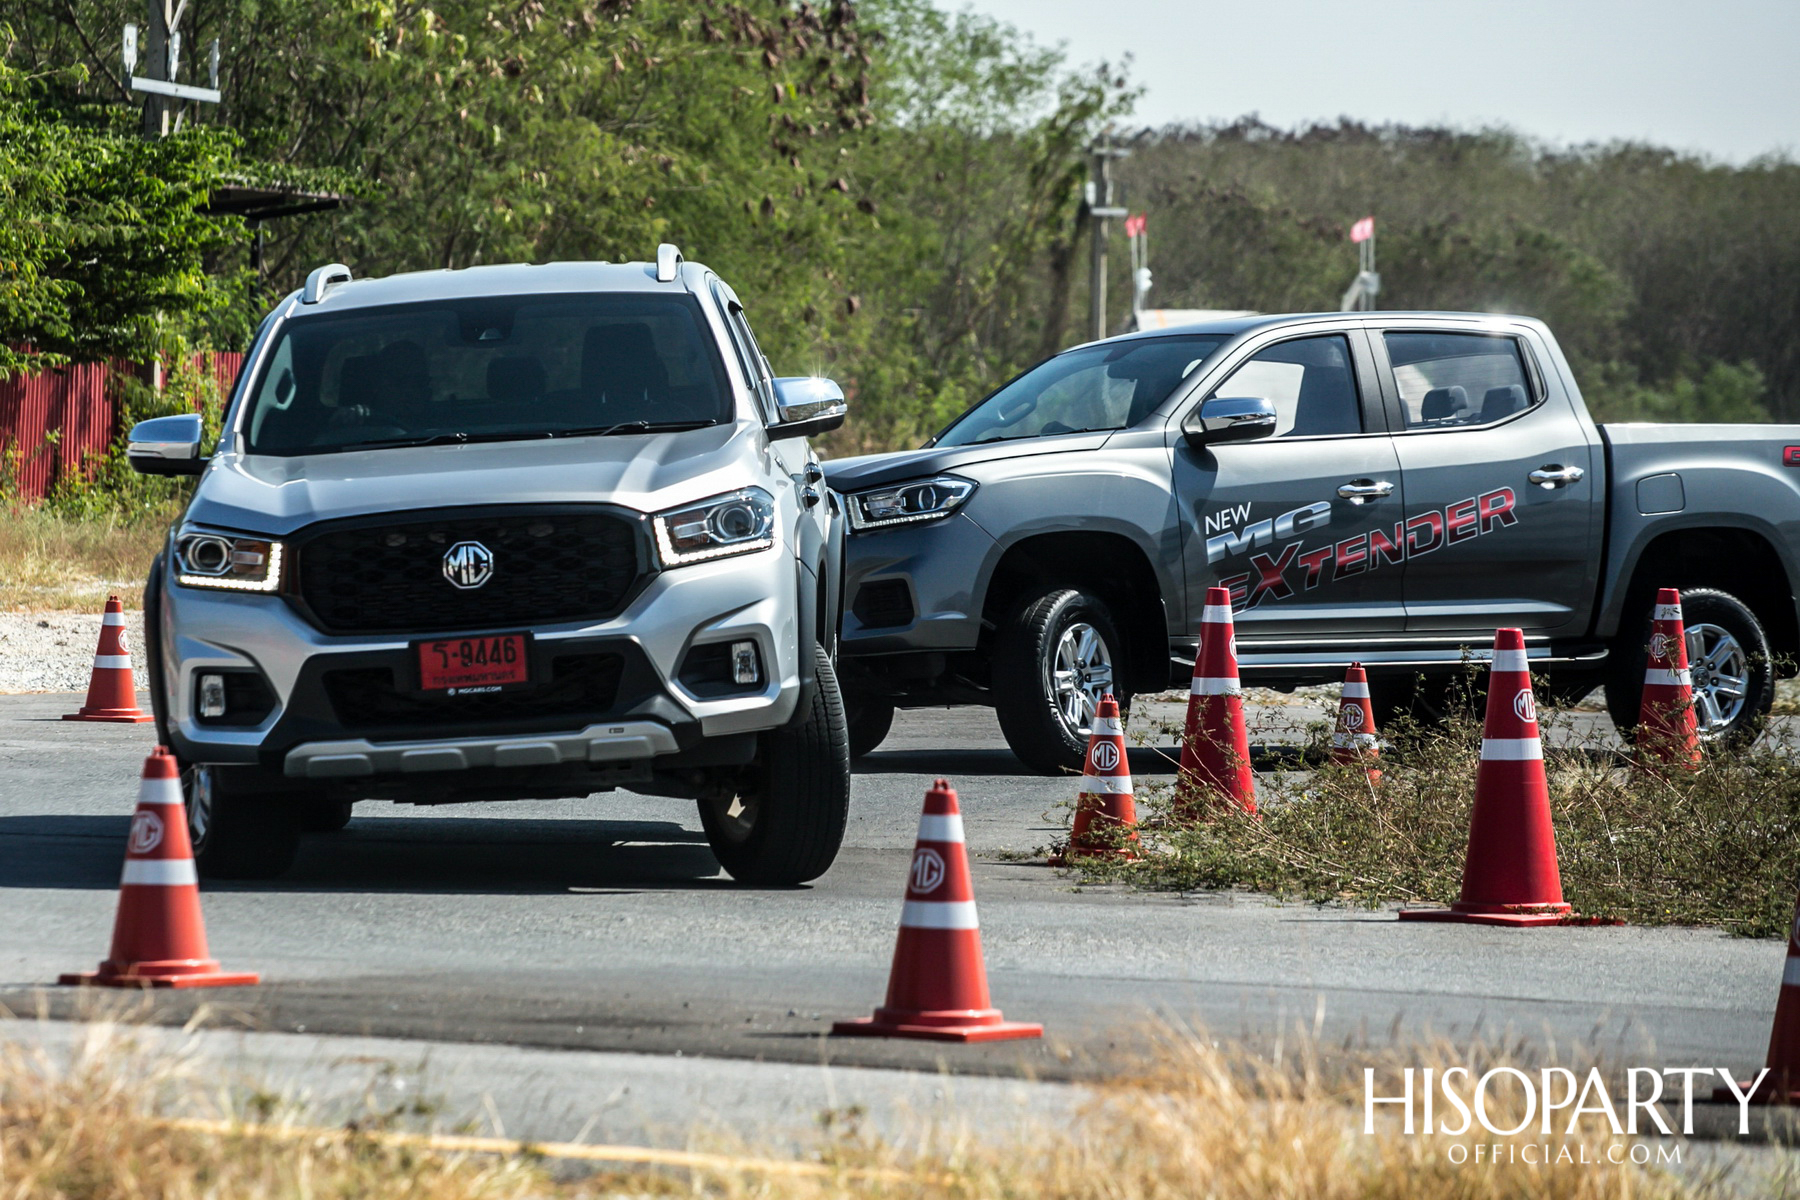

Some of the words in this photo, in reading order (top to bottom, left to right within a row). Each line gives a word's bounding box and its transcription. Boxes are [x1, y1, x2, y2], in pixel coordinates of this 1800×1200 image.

[1205, 501, 1251, 535] NEW
[1206, 501, 1332, 565] MG
[447, 544, 489, 585] MG
[1218, 486, 1519, 615] EXTENDER
[1093, 743, 1118, 769] MG
[911, 852, 939, 888] MG
